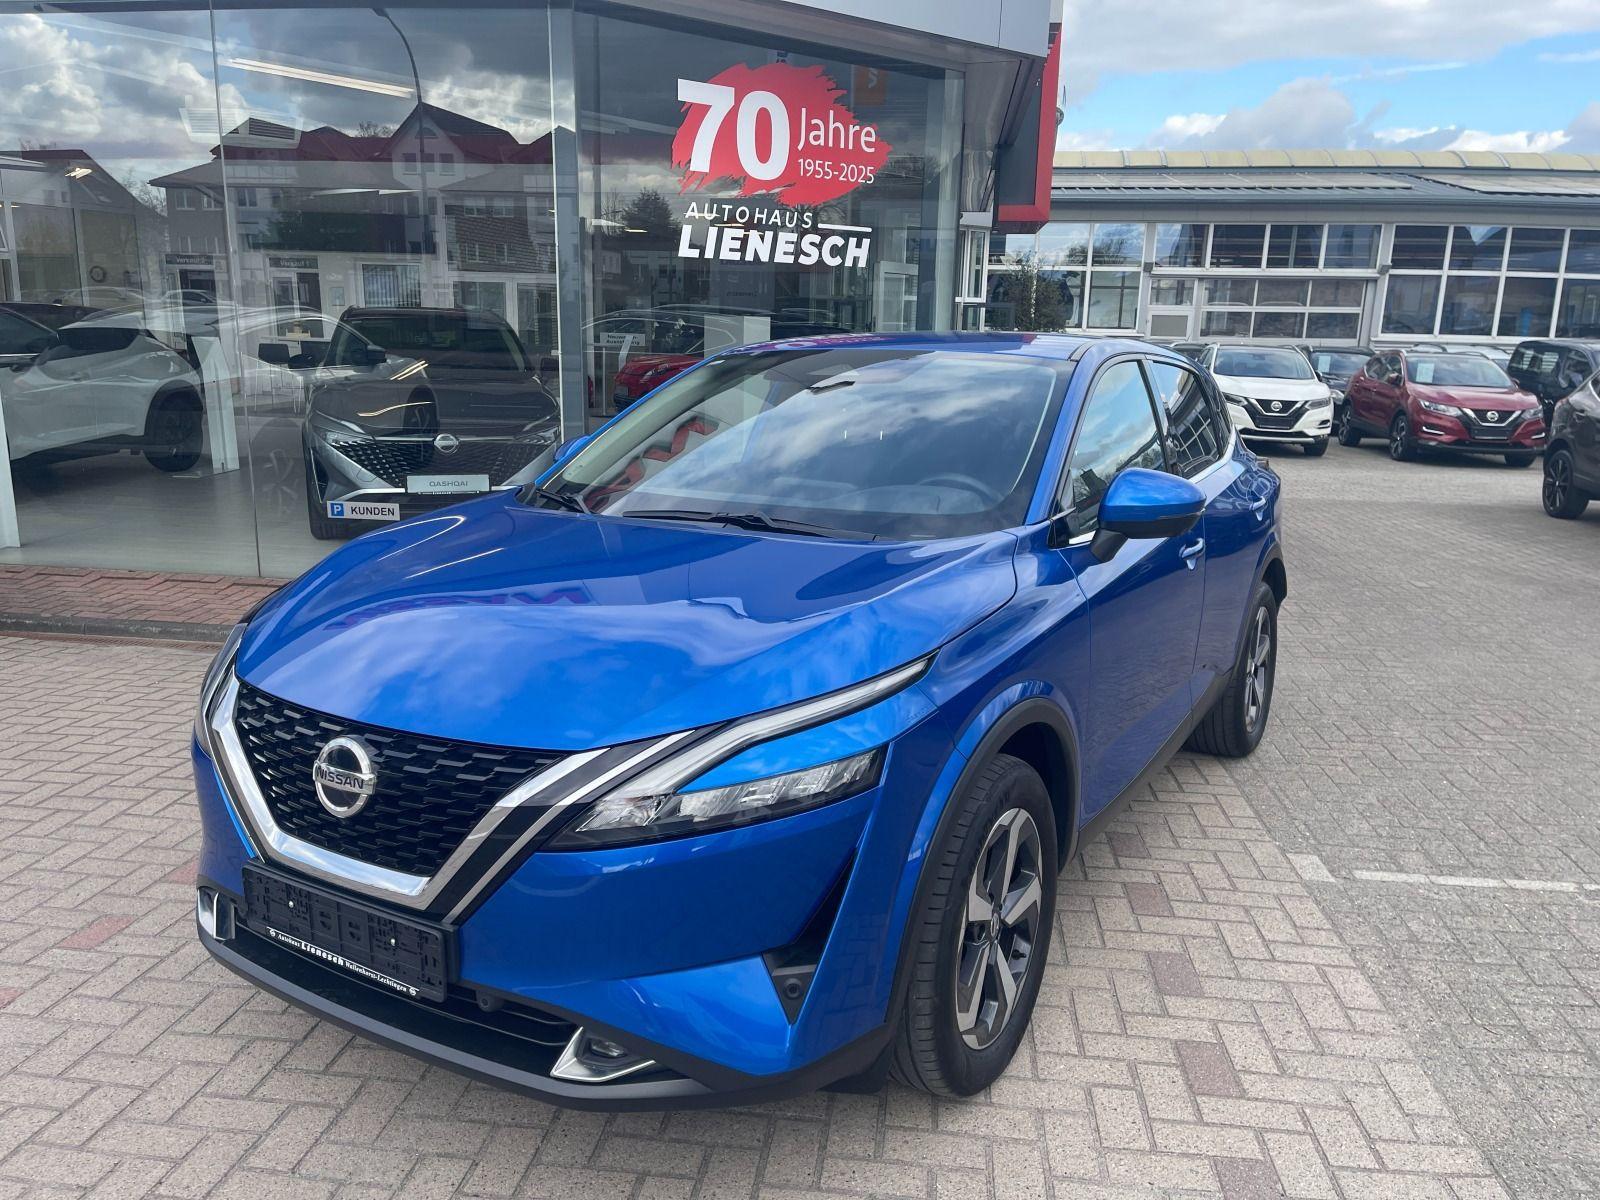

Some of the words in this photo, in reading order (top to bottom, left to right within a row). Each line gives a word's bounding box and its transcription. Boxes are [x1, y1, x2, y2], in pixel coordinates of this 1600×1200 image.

[677, 78, 790, 181] 70
[797, 107, 876, 153] Jahre
[797, 158, 875, 184] 1955-2025
[685, 201, 813, 229] AUTOHAUS
[677, 224, 871, 268] LIENESCH
[350, 506, 395, 516] KUNDEN
[317, 768, 364, 789] NISSAN
[277, 933, 300, 947] Autohaus
[301, 942, 344, 966] Lienesch
